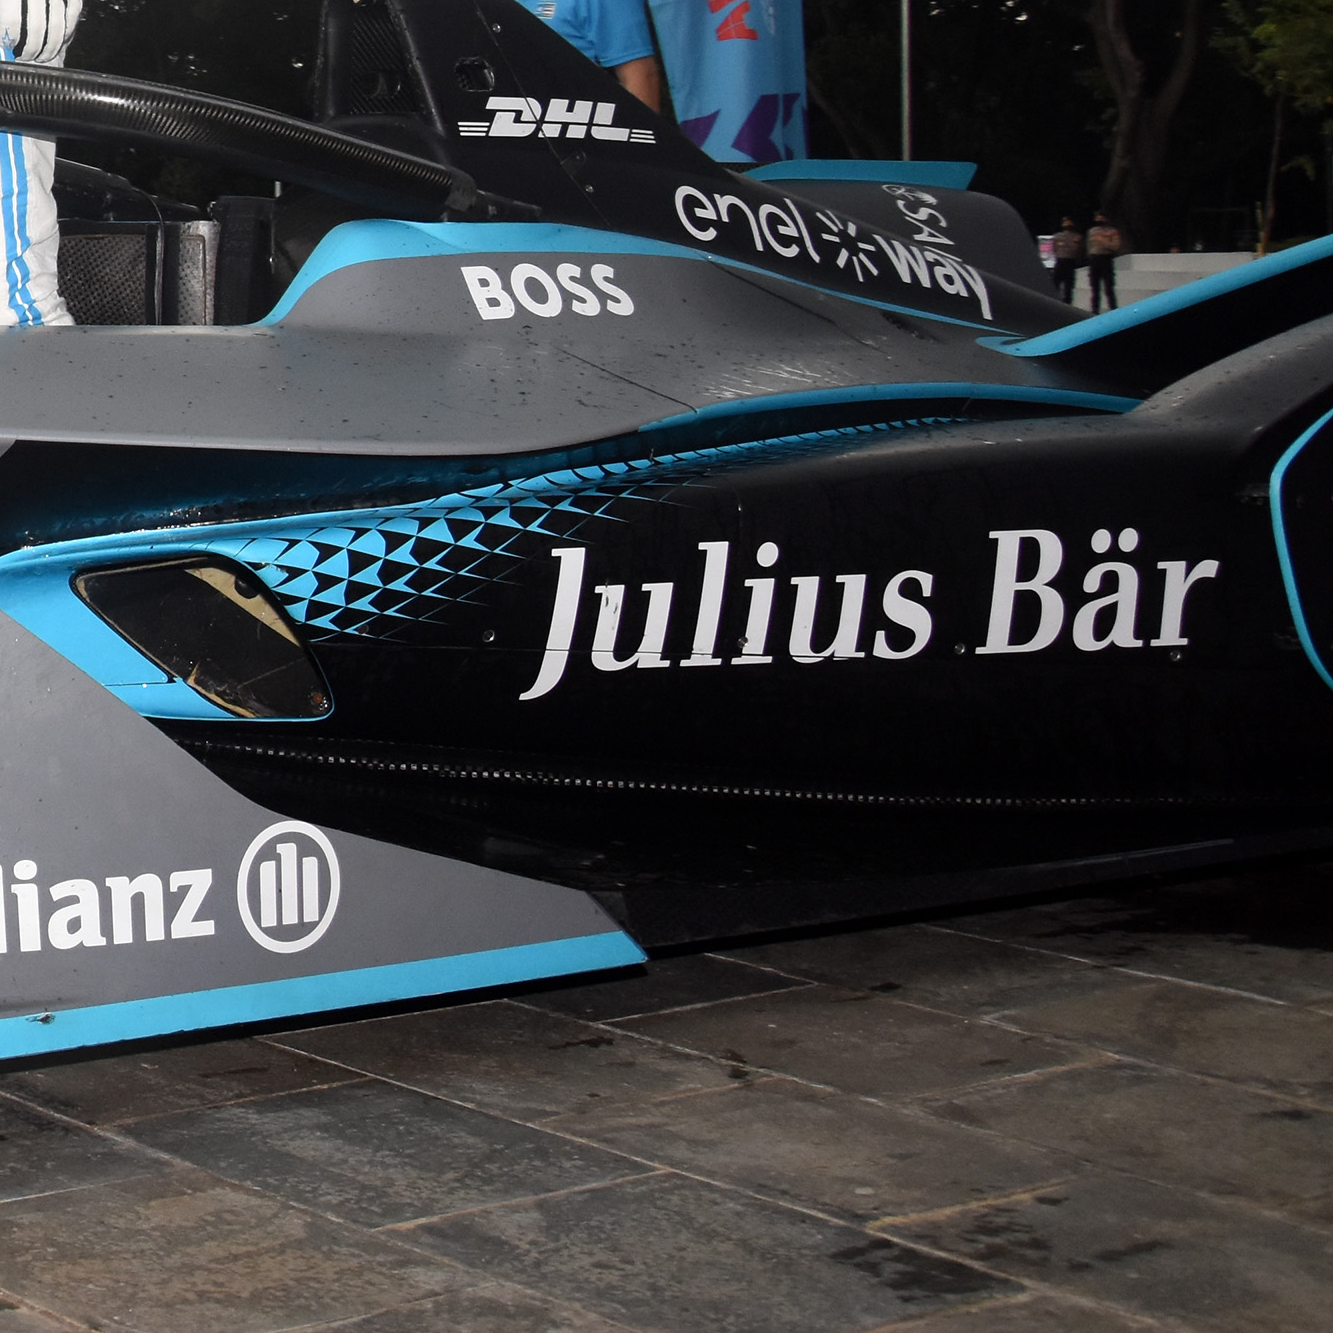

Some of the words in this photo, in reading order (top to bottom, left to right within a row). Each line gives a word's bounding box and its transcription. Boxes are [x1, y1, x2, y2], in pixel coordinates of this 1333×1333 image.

[485, 96, 631, 139] DHL
[460, 262, 635, 321] BOSS
[675, 185, 820, 264] enel
[872, 234, 993, 320] way
[519, 540, 933, 701] Julius
[975, 527, 1219, 656] Bär
